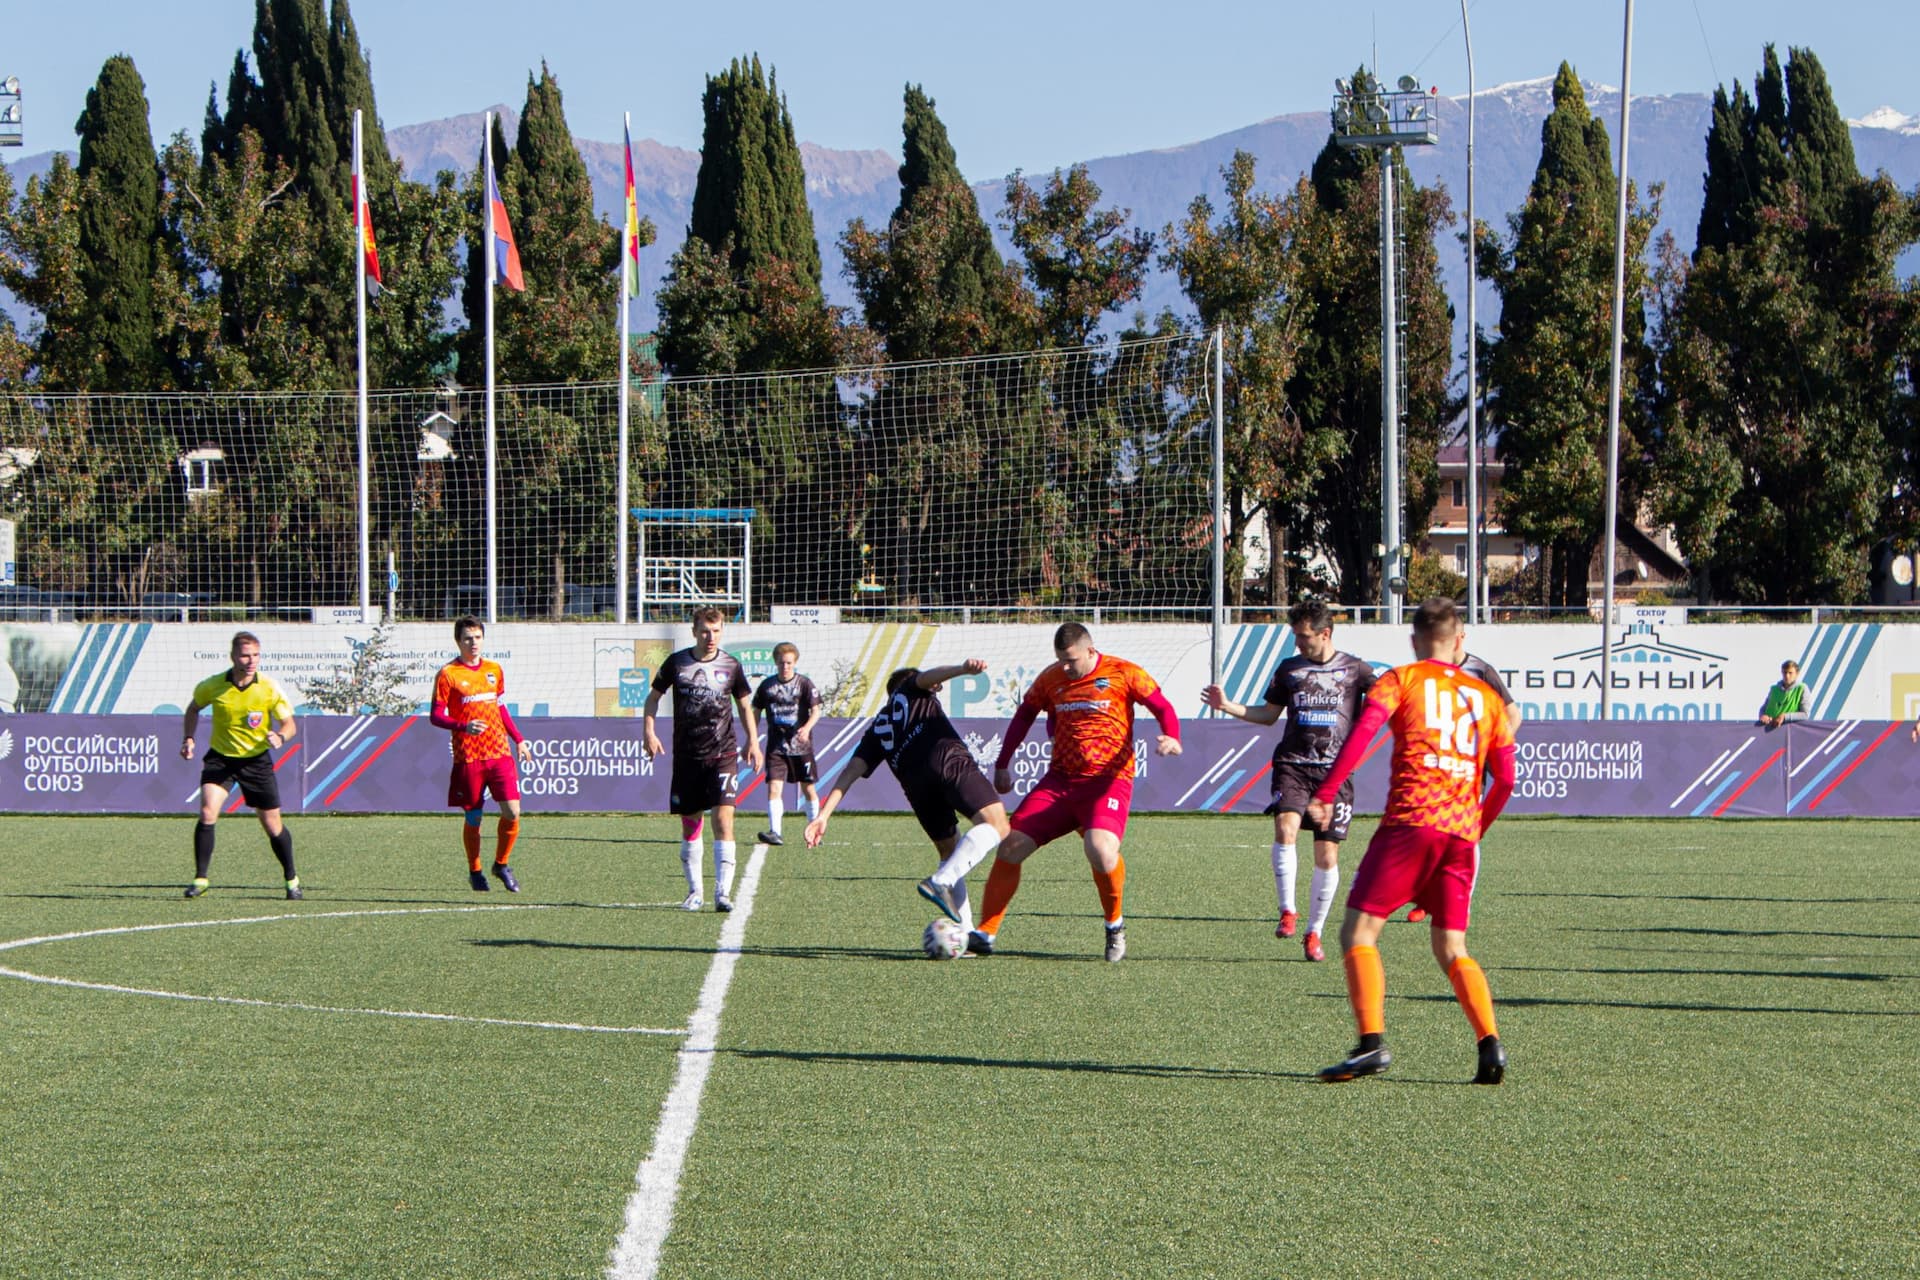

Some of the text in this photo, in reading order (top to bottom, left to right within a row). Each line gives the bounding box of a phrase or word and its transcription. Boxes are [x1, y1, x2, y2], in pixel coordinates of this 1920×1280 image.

[789, 609, 819, 617] СЕКТОР
[1636, 609, 1666, 617] СЕКТОР
[493, 650, 512, 659] and
[1424, 678, 1484, 757] 42
[24, 734, 159, 754] РОССИЙСКИЙ
[24, 754, 159, 773] ФУТБОЛЬНЫЙ
[521, 757, 653, 776] ФУТБОЛЬНЫЙ
[24, 774, 84, 792] СОЮЗ
[521, 777, 579, 795] СОЮЗ
[718, 773, 738, 791] 76
[1334, 802, 1352, 825] 33
